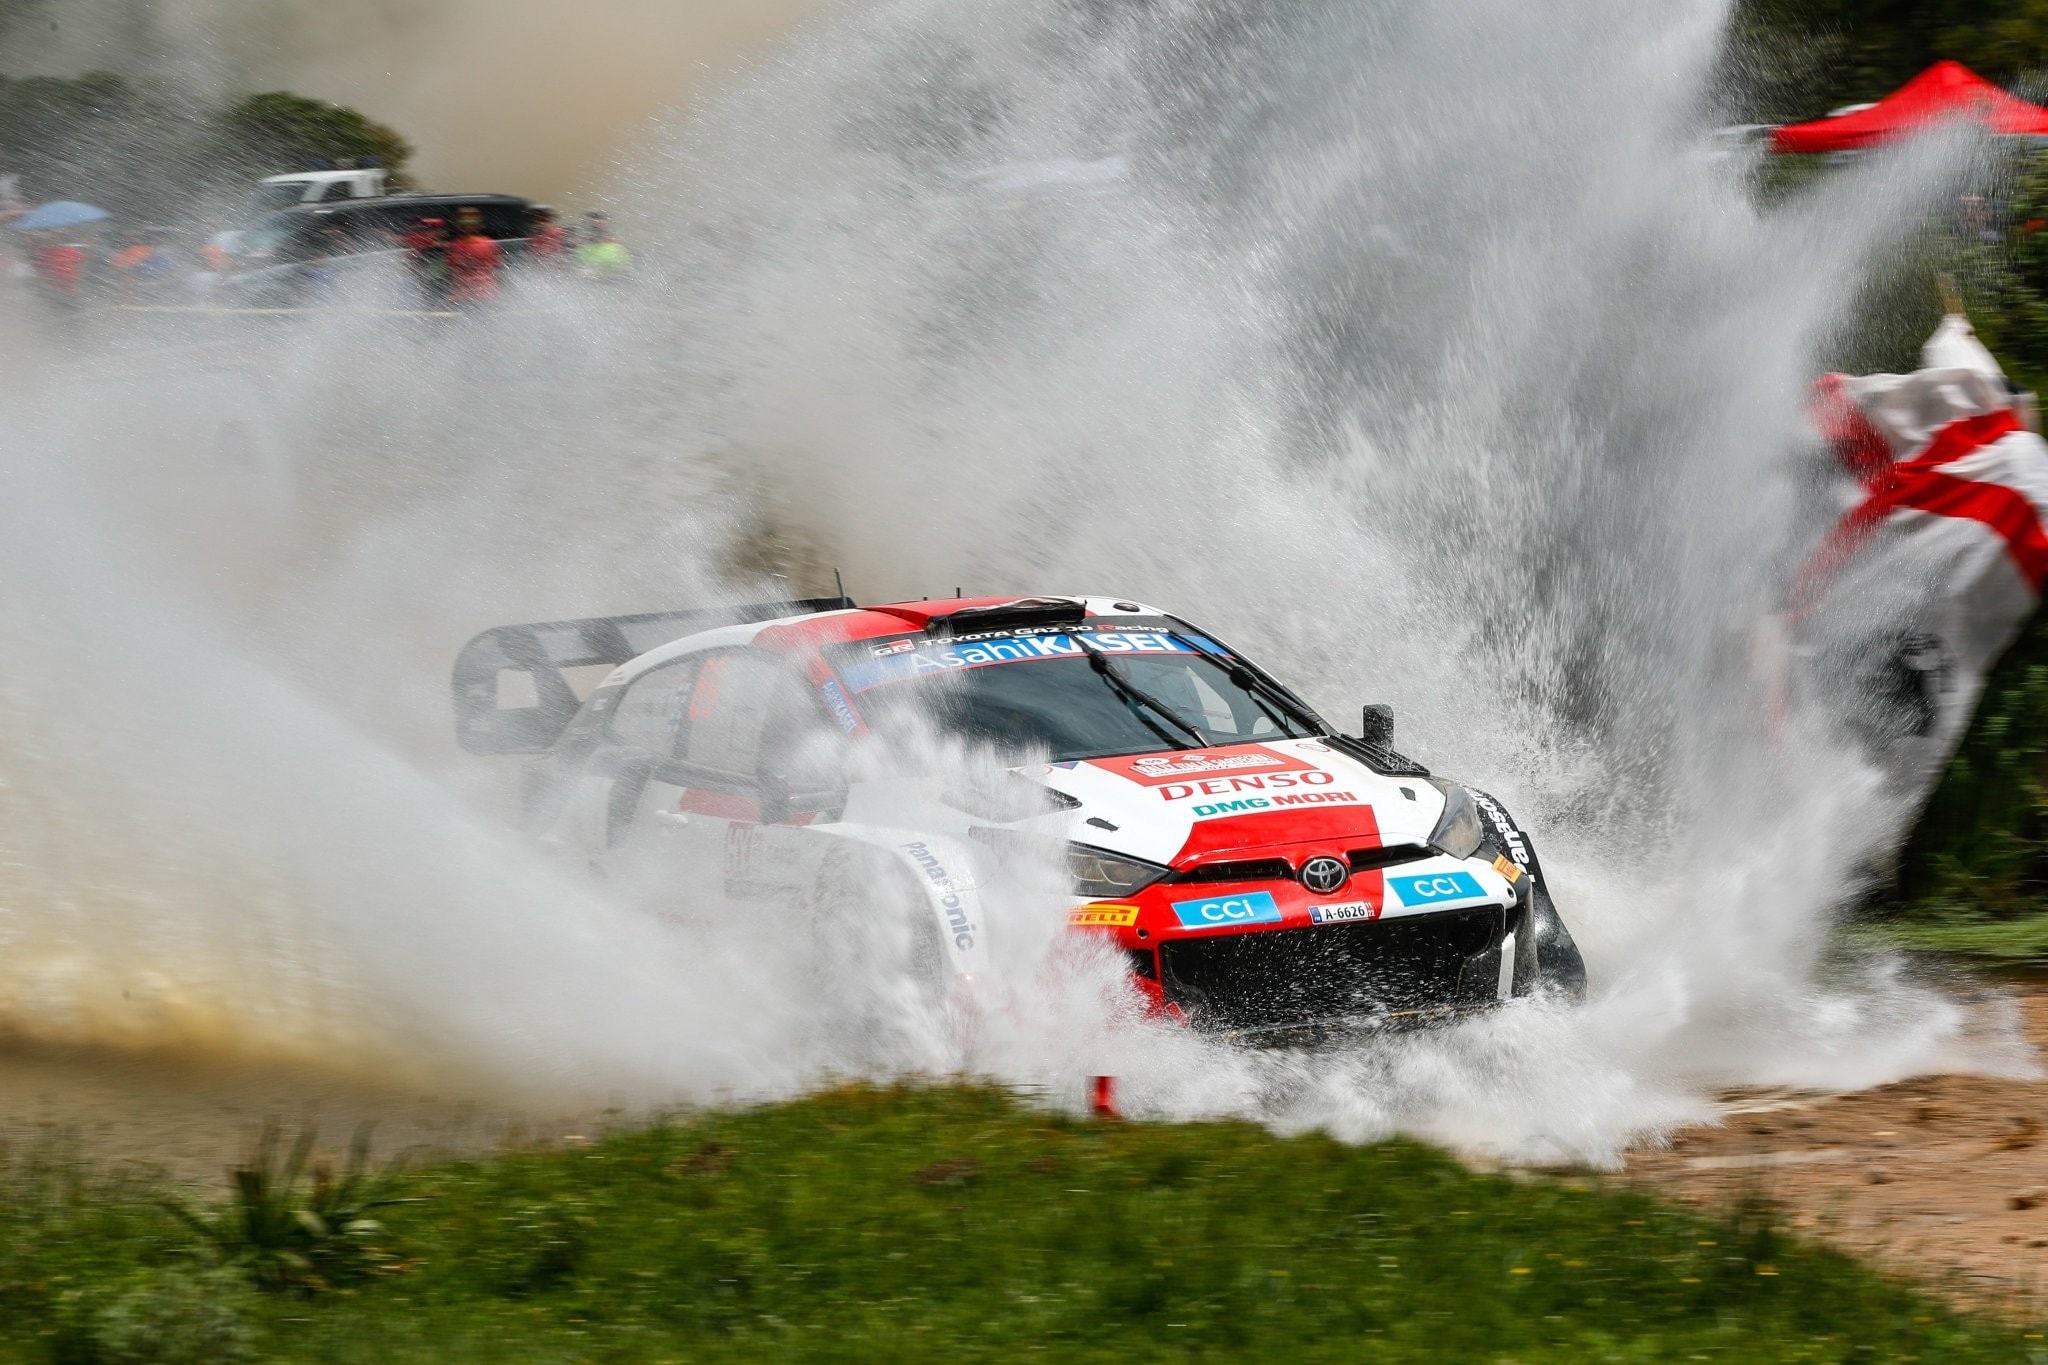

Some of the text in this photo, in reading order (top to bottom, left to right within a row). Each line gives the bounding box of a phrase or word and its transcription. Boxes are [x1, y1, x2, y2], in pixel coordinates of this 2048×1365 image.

[919, 629, 1010, 646] TOYOTA
[1096, 623, 1169, 634] Racing
[1158, 771, 1334, 801] DENSO
[1192, 791, 1359, 817] DMG MORI
[898, 841, 977, 952] Panaonic
[1325, 905, 1365, 919] A-6626
